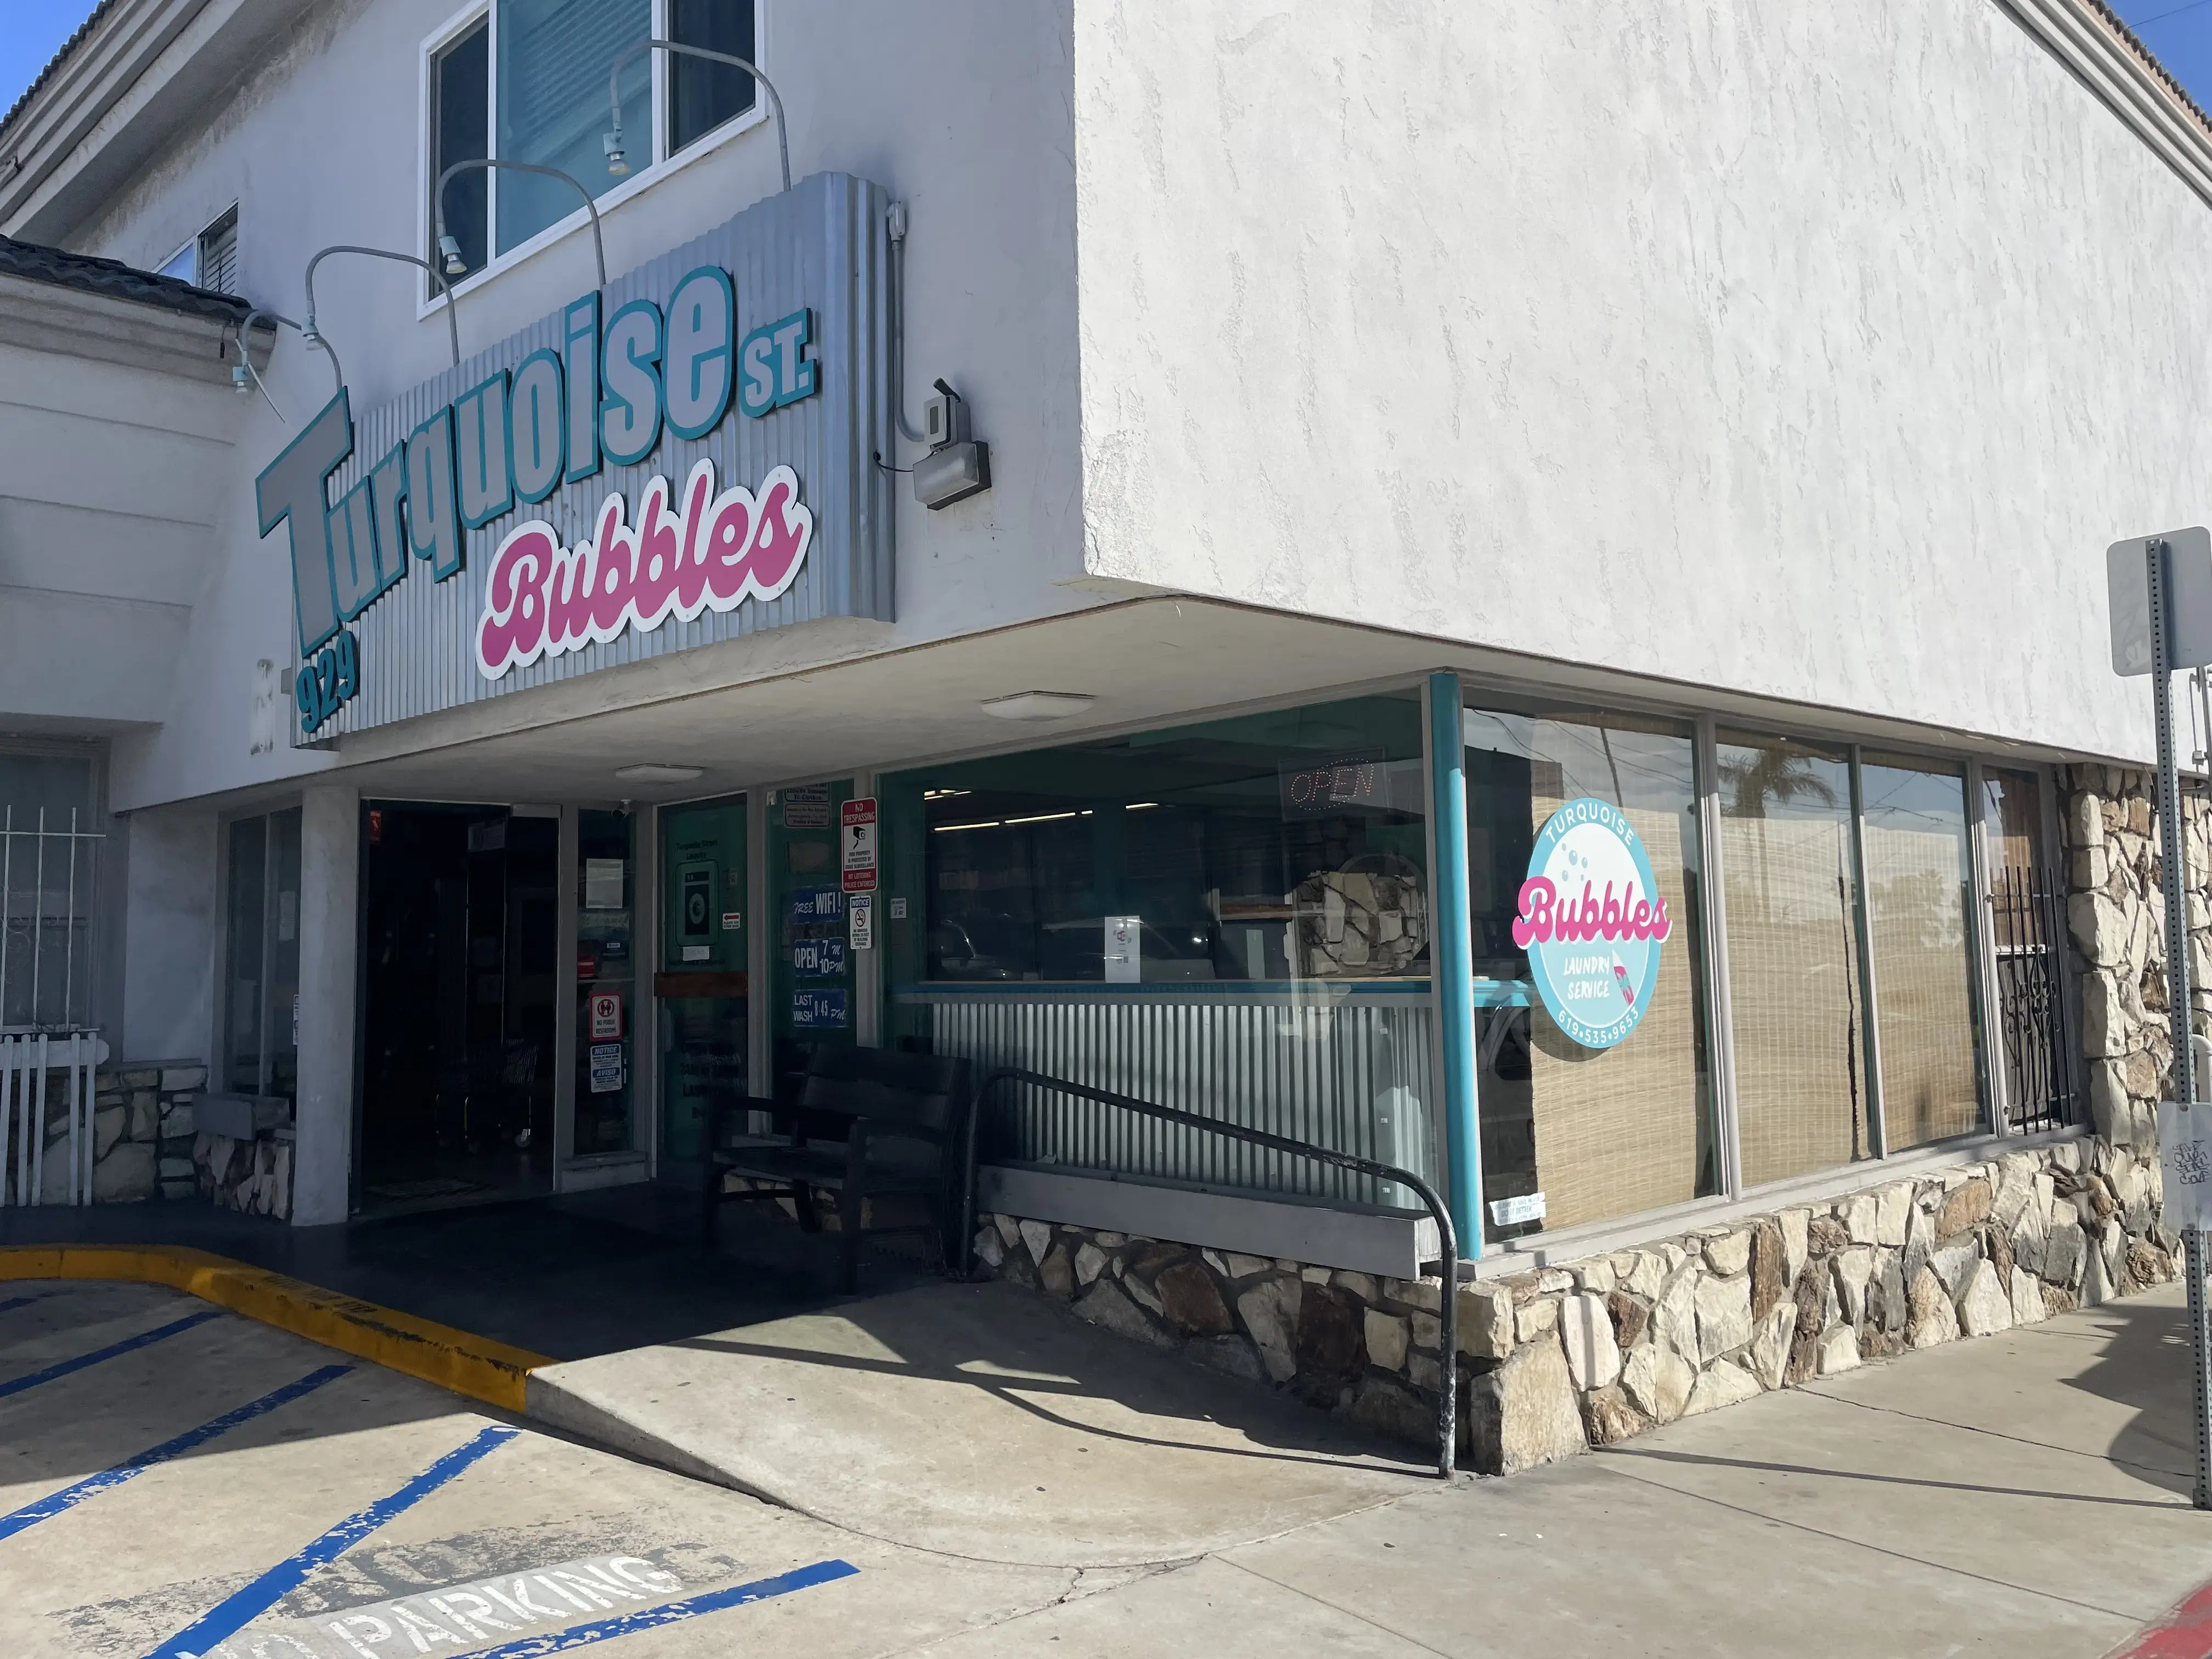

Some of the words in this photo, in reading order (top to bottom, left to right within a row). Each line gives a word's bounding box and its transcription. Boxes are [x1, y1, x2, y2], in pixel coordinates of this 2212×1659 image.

[256, 266, 734, 658] Turquoise
[740, 308, 817, 418] ST.
[478, 466, 809, 674] Bubbles
[295, 630, 360, 733] 929
[1290, 763, 1374, 802] OPEN
[855, 803, 864, 812] NO
[843, 811, 875, 824] TRESPASSING
[1545, 803, 1634, 847] TURQUOISE
[792, 901, 814, 915] FREE
[851, 899, 870, 907] NOTICE
[1512, 876, 1673, 949] Bubbles
[822, 939, 828, 956] 7
[794, 947, 817, 968] OPEN
[1564, 956, 1610, 977] LAUNDRY
[1567, 980, 1610, 1000] SERVICE
[794, 994, 812, 1006] LAST
[793, 1010, 812, 1022] WASH
[830, 1008, 845, 1021] PM
[594, 1046, 618, 1055] NOTICE
[596, 1068, 616, 1077] AVISO
[328, 1556, 684, 1659] PARKING
